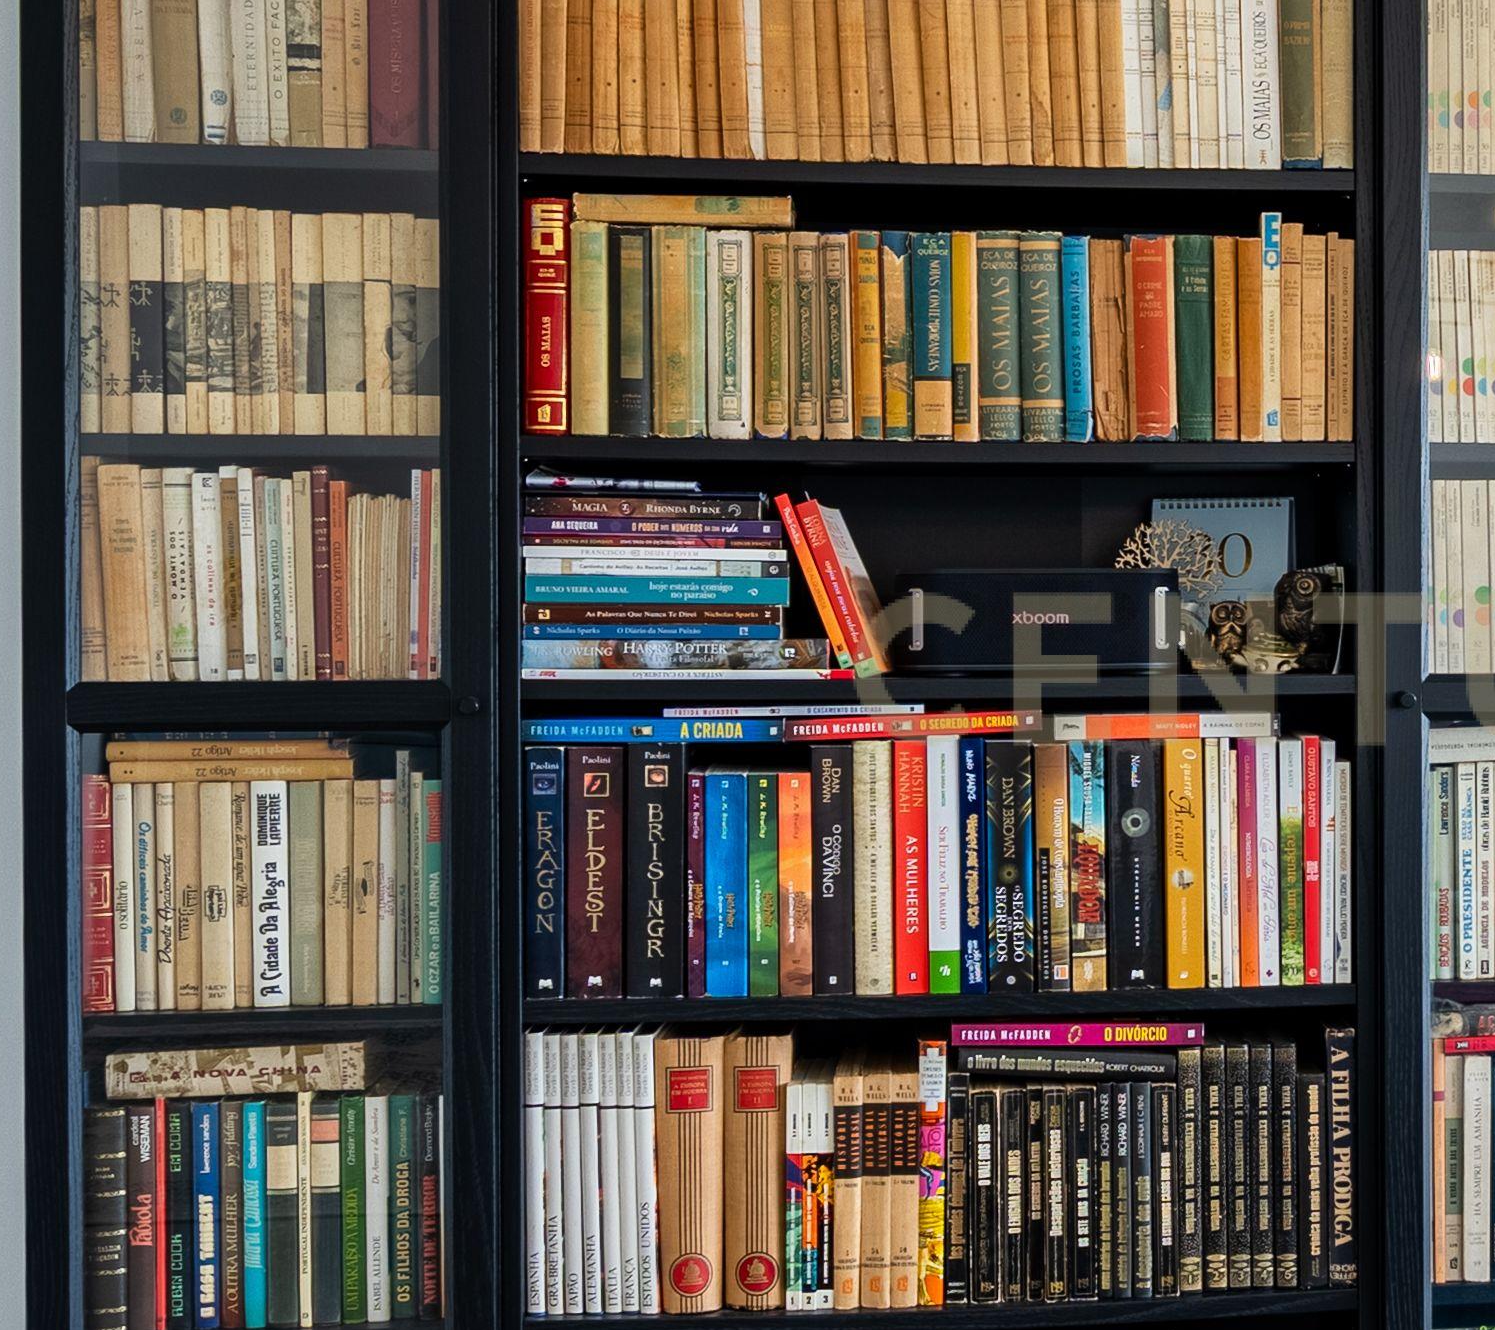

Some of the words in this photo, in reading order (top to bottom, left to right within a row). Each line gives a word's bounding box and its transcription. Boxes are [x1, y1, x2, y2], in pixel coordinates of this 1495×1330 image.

[981, 262, 1018, 270] QUEIROZ
[1021, 263, 1056, 272] QUEIROZ
[991, 277, 1010, 350] MAIAS
[1031, 279, 1050, 353] MAIAS
[993, 358, 1011, 390] OS
[1032, 361, 1051, 393] OS
[572, 503, 608, 512] MAGIA
[646, 504, 687, 513] RHONDA
[690, 506, 721, 514] BYRNE
[649, 581, 667, 591] hoje
[669, 582, 699, 590] estarás
[701, 583, 733, 592] comigo
[684, 591, 716, 600] paraíso
[1012, 612, 1069, 624] xboom
[624, 642, 673, 654] HARRY
[676, 643, 727, 654] POTTER
[531, 726, 566, 735] FREIDA
[571, 726, 623, 735] McFADDEN
[680, 723, 689, 738] A
[693, 723, 743, 739] CRIADA
[794, 725, 828, 736] FREIDA
[833, 722, 883, 734] McFADDEN
[920, 719, 926, 730] O
[929, 717, 969, 730] SEGREDO
[972, 716, 983, 728] DA
[986, 715, 1018, 727] CRIADA
[531, 762, 559, 770] Paolini
[583, 756, 611, 765] Paolini
[1308, 747, 1316, 787] GUSTAVO
[822, 758, 832, 803] BROWN
[832, 768, 841, 793] DAN
[899, 752, 910, 813] HANNAH
[912, 757, 924, 808] KRISTIN
[1001, 777, 1014, 805] DAN
[257, 793, 267, 846] DOMINIQUE
[270, 793, 280, 846] LAPIERRE
[1308, 789, 1316, 827] SANTOS
[832, 824, 842, 834] O
[906, 835, 918, 854] AS
[1002, 808, 1015, 859] BROWN
[259, 862, 285, 913] Alegria
[536, 812, 560, 933] ERAGON
[585, 809, 606, 932] ELDEST
[647, 804, 665, 958] BRISINGR
[906, 859, 919, 934] MULHERES
[1464, 849, 1472, 939] PRESIDENTE
[259, 915, 278, 935] Da
[996, 886, 1007, 963] SEGREDOS
[1013, 892, 1025, 962] SEGREDO
[260, 937, 282, 981] Cidade
[1464, 944, 1472, 953] O
[261, 985, 283, 997] A
[962, 1030, 996, 1040] FREIDA
[1001, 1030, 1051, 1039] McFADDEN
[1105, 1028, 1112, 1041] O
[1116, 1026, 1167, 1041] DIVÓRCIO
[193, 1069, 247, 1078] NOVA
[259, 1065, 321, 1076] CHINA
[1331, 1046, 1349, 1063] A
[1332, 1070, 1351, 1141] FILHA
[396, 1161, 409, 1207] DROGA
[1333, 1147, 1353, 1247] PRÓDIGA
[397, 1210, 409, 1228] DA
[641, 1201, 650, 1247] UNIDOS
[397, 1232, 410, 1280] FILHOS
[549, 1214, 558, 1307] GRÃ-BRETANHA
[587, 1234, 596, 1304] ALEMANHA
[397, 1285, 410, 1302] OS
[530, 1251, 540, 1306] ESPANHA
[568, 1273, 578, 1308] JAPÃO
[608, 1264, 617, 1308] ITÁLIA
[625, 1257, 635, 1307] FRANÇA
[642, 1249, 653, 1308] ESTADOS
